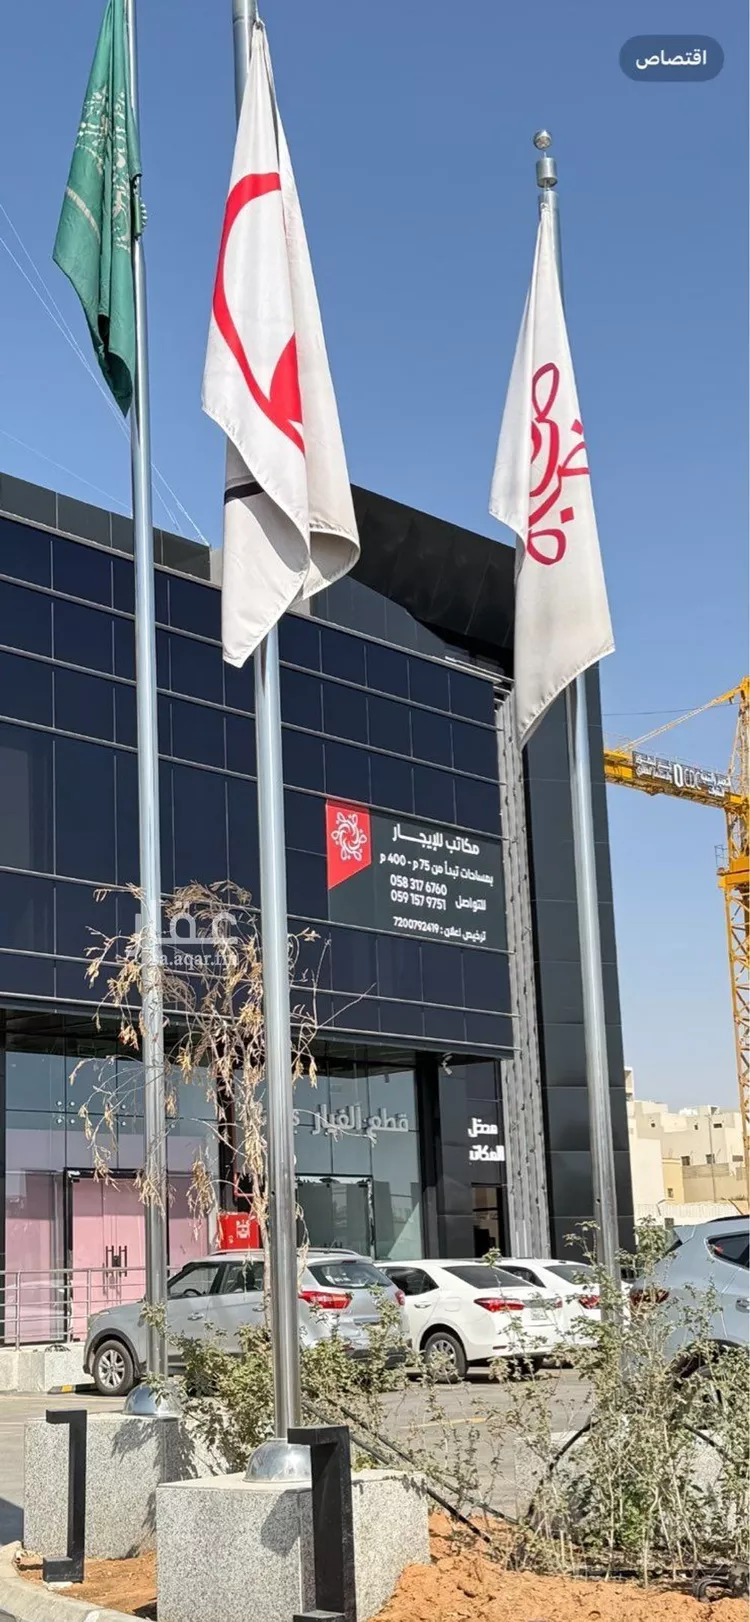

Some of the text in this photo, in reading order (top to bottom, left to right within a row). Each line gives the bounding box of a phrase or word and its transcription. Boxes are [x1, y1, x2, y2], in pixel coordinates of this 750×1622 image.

[445, 836, 480, 856] مكاتب
[379, 852, 386, 864] م
[387, 853, 406, 867] 400
[419, 858, 431, 872] 75
[431, 864, 444, 875] من
[444, 860, 460, 880] تبدأ
[460, 868, 494, 887] بمساحات
[390, 874, 447, 896] 058 317 6760
[390, 889, 446, 911] 059 157 9751
[455, 895, 487, 912] للتواصل
[392, 916, 439, 934] 7200792419
[462, 930, 486, 943] ترخيص
[312, 1104, 361, 1135] الغيار
[366, 1108, 409, 1138] قطع
